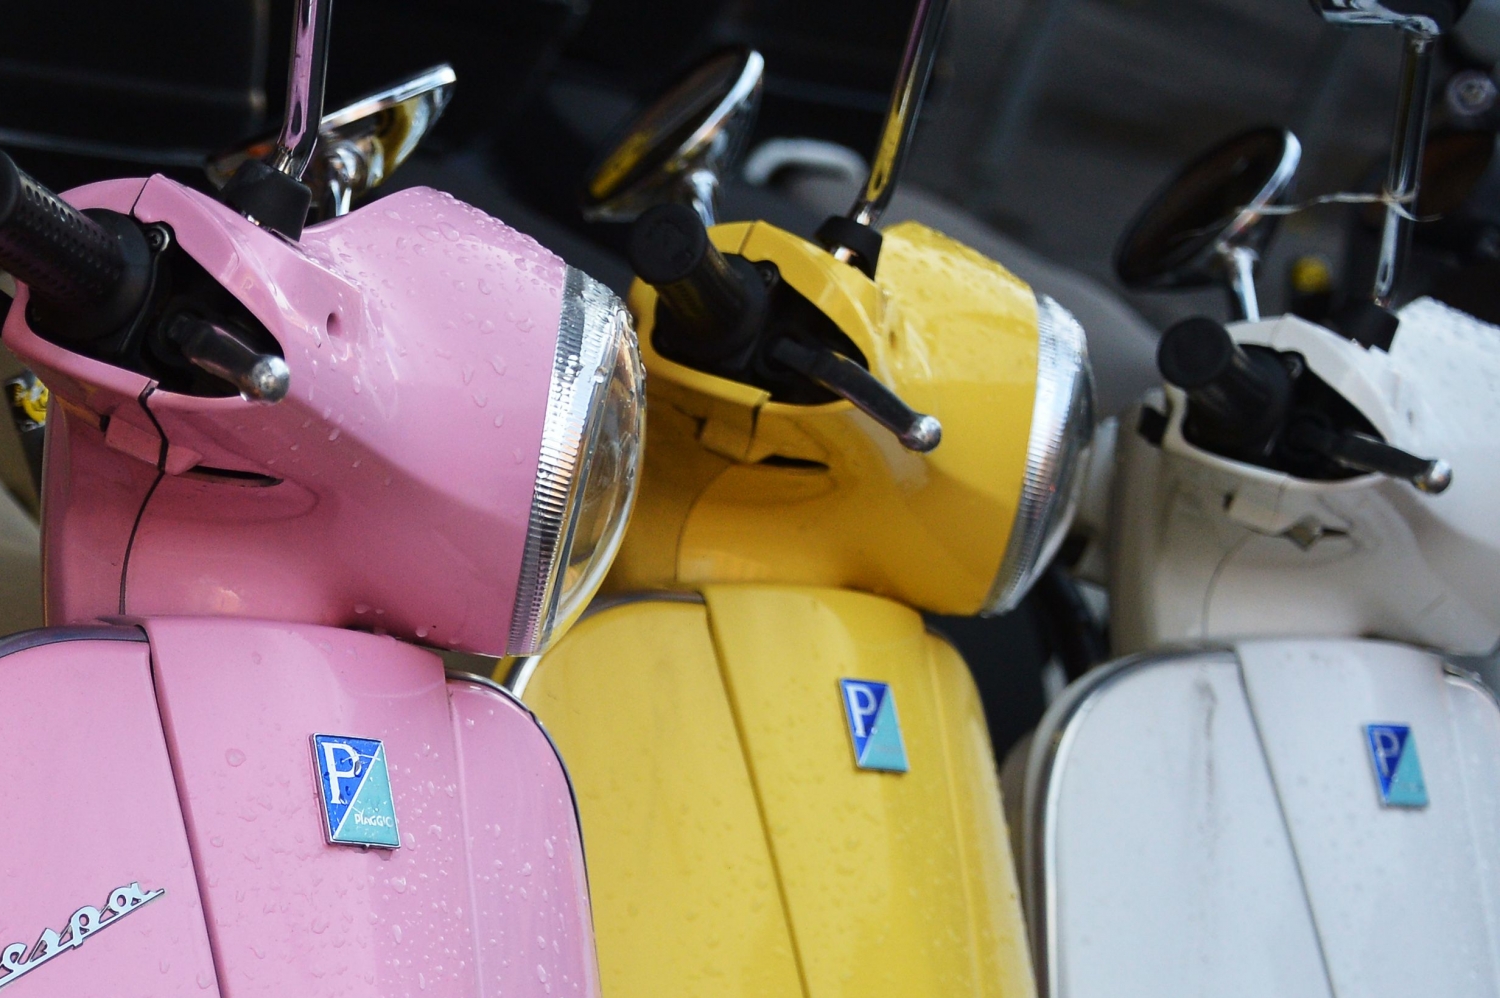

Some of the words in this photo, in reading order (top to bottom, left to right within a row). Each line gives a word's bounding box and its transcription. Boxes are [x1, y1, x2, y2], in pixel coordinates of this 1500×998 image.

[845, 684, 877, 737] P
[321, 742, 360, 804] P
[1374, 727, 1402, 777] P
